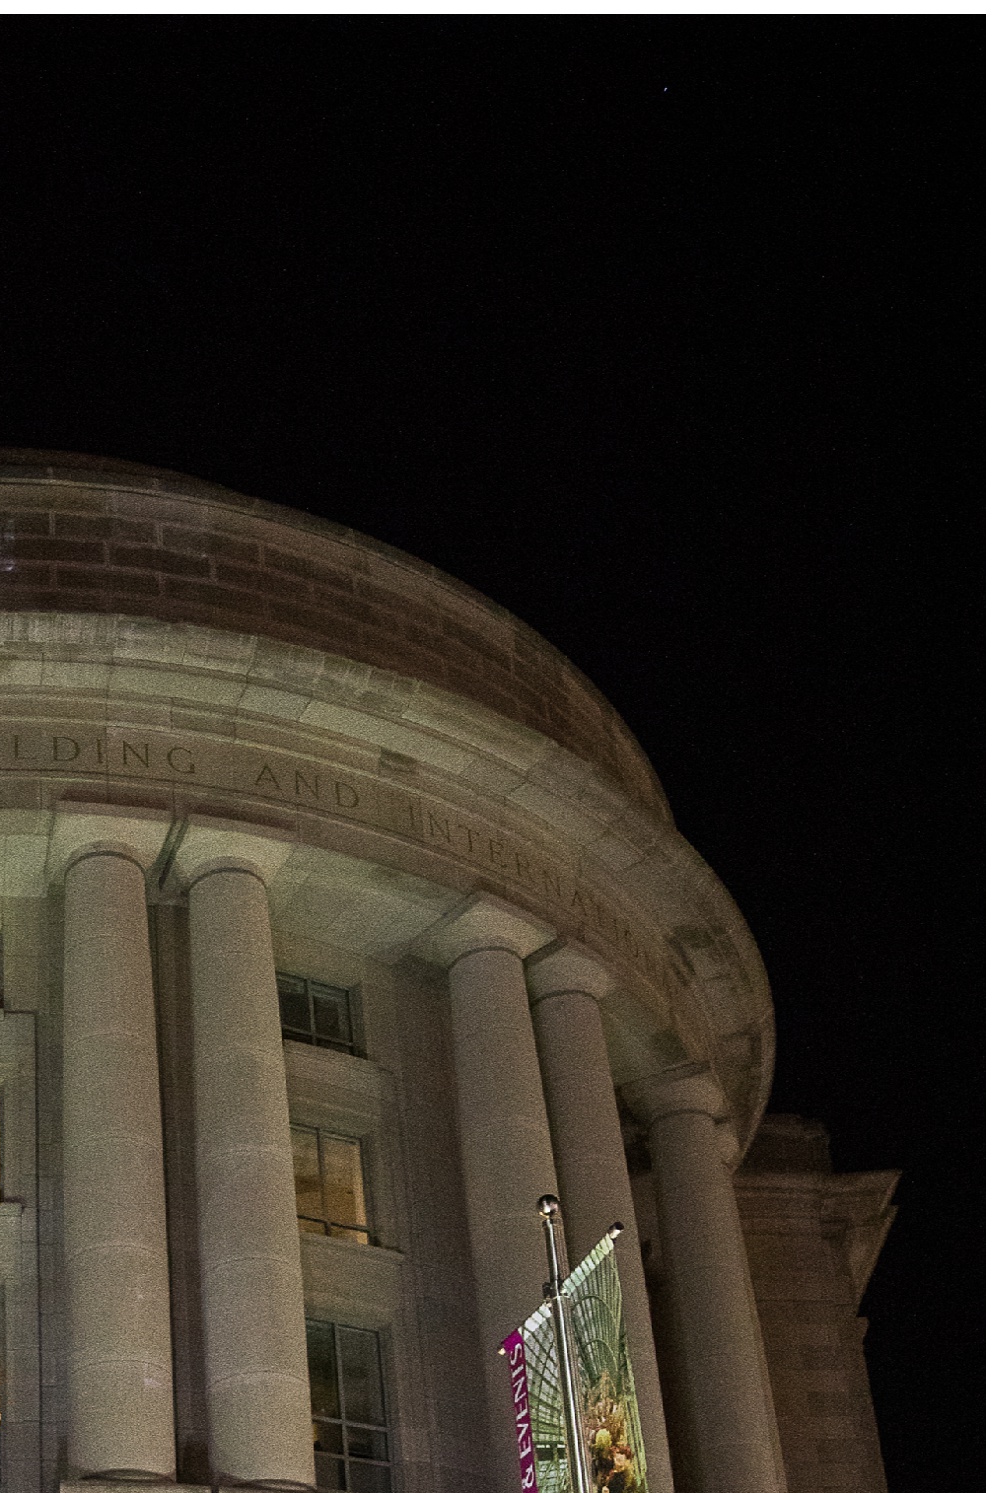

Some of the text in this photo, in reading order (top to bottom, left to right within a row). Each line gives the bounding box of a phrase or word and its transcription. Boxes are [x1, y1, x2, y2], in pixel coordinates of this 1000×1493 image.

[254, 760, 361, 811] AND
[509, 1342, 532, 1459] EVENTS
[521, 1463, 534, 1490] &
